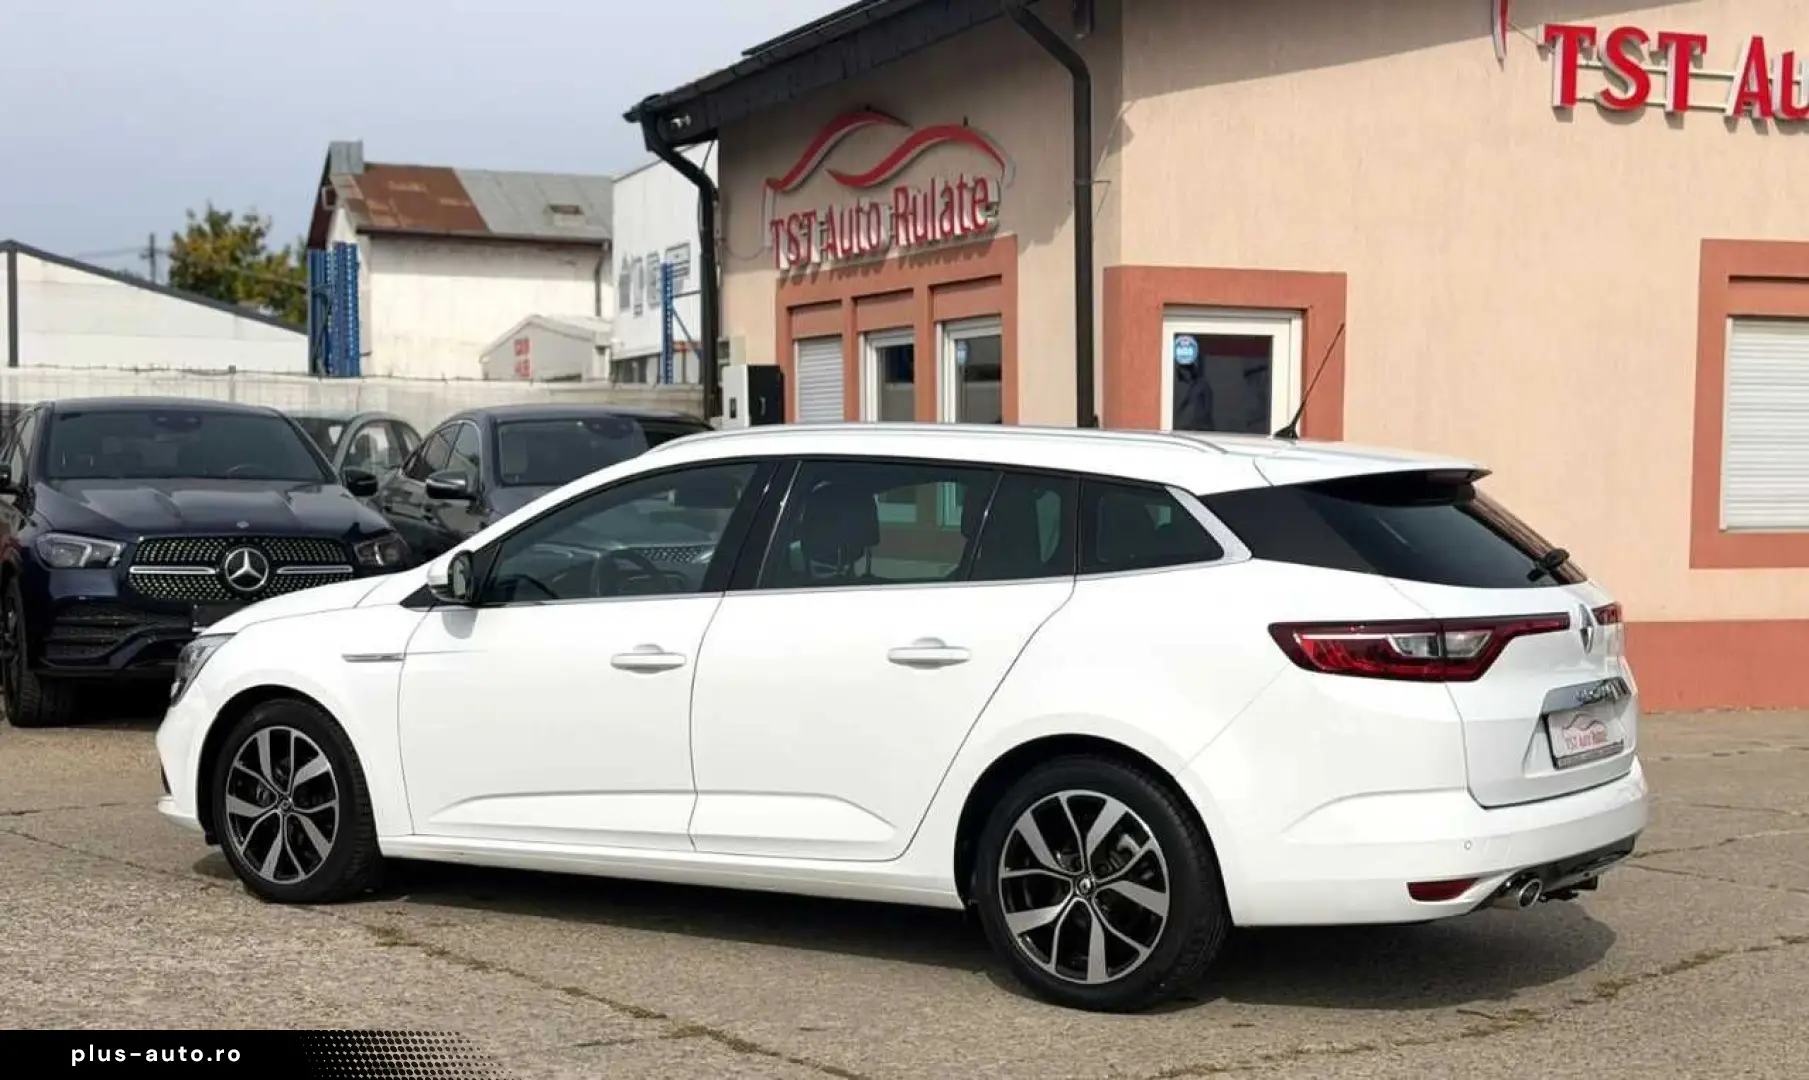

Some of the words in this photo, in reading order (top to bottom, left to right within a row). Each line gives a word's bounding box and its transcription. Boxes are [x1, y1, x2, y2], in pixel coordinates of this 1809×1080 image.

[1542, 23, 1707, 113] TST
[770, 208, 818, 270] TST
[823, 197, 884, 259] Auto
[892, 173, 990, 247] Rulate
